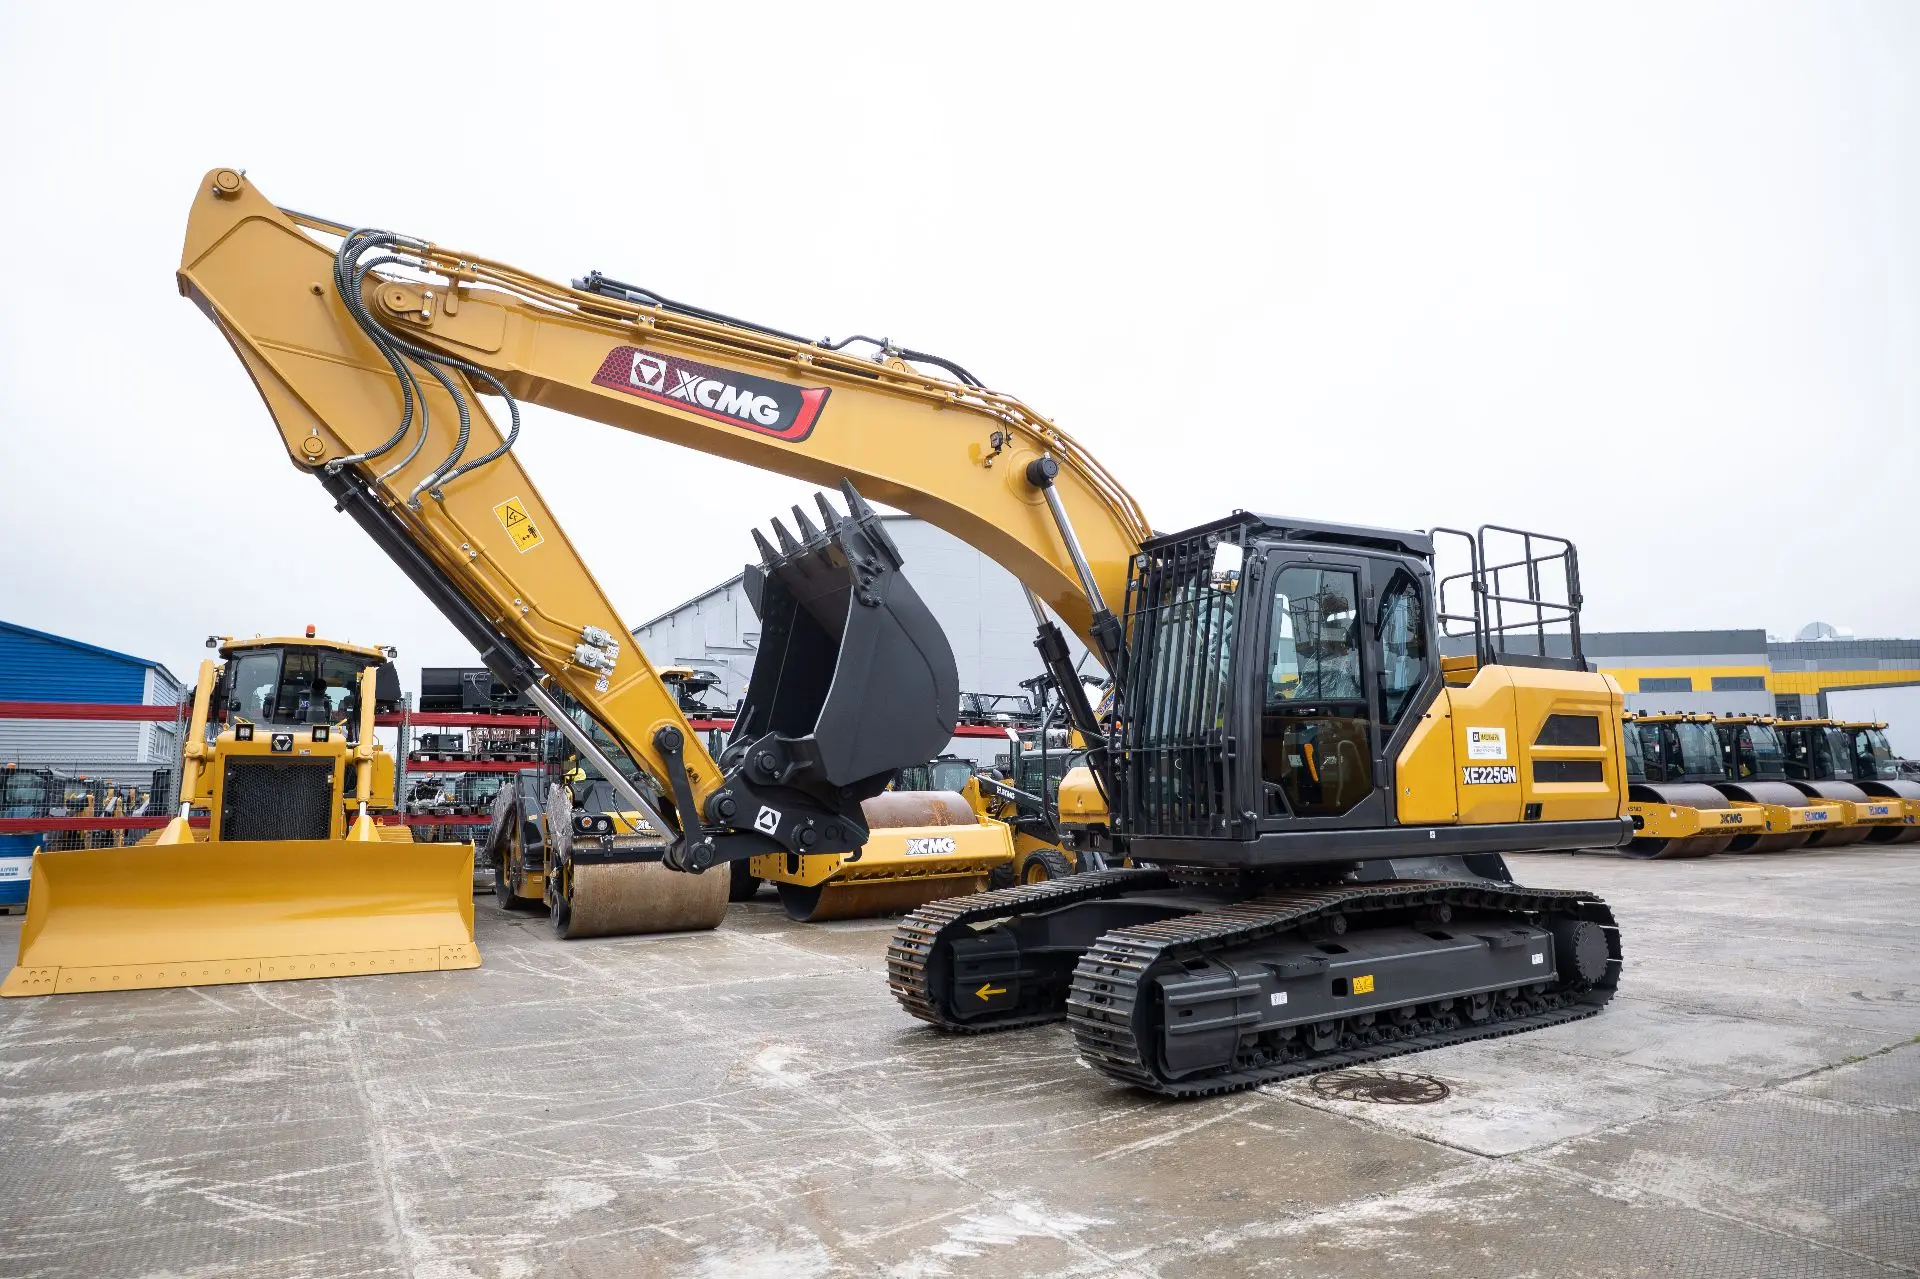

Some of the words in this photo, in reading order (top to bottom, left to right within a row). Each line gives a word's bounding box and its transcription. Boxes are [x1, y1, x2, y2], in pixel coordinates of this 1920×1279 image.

[665, 368, 780, 426] XCMG
[1462, 766, 1517, 784] XE225GN
[1719, 812, 1742, 824] XCMG
[905, 837, 956, 855] XCMG
